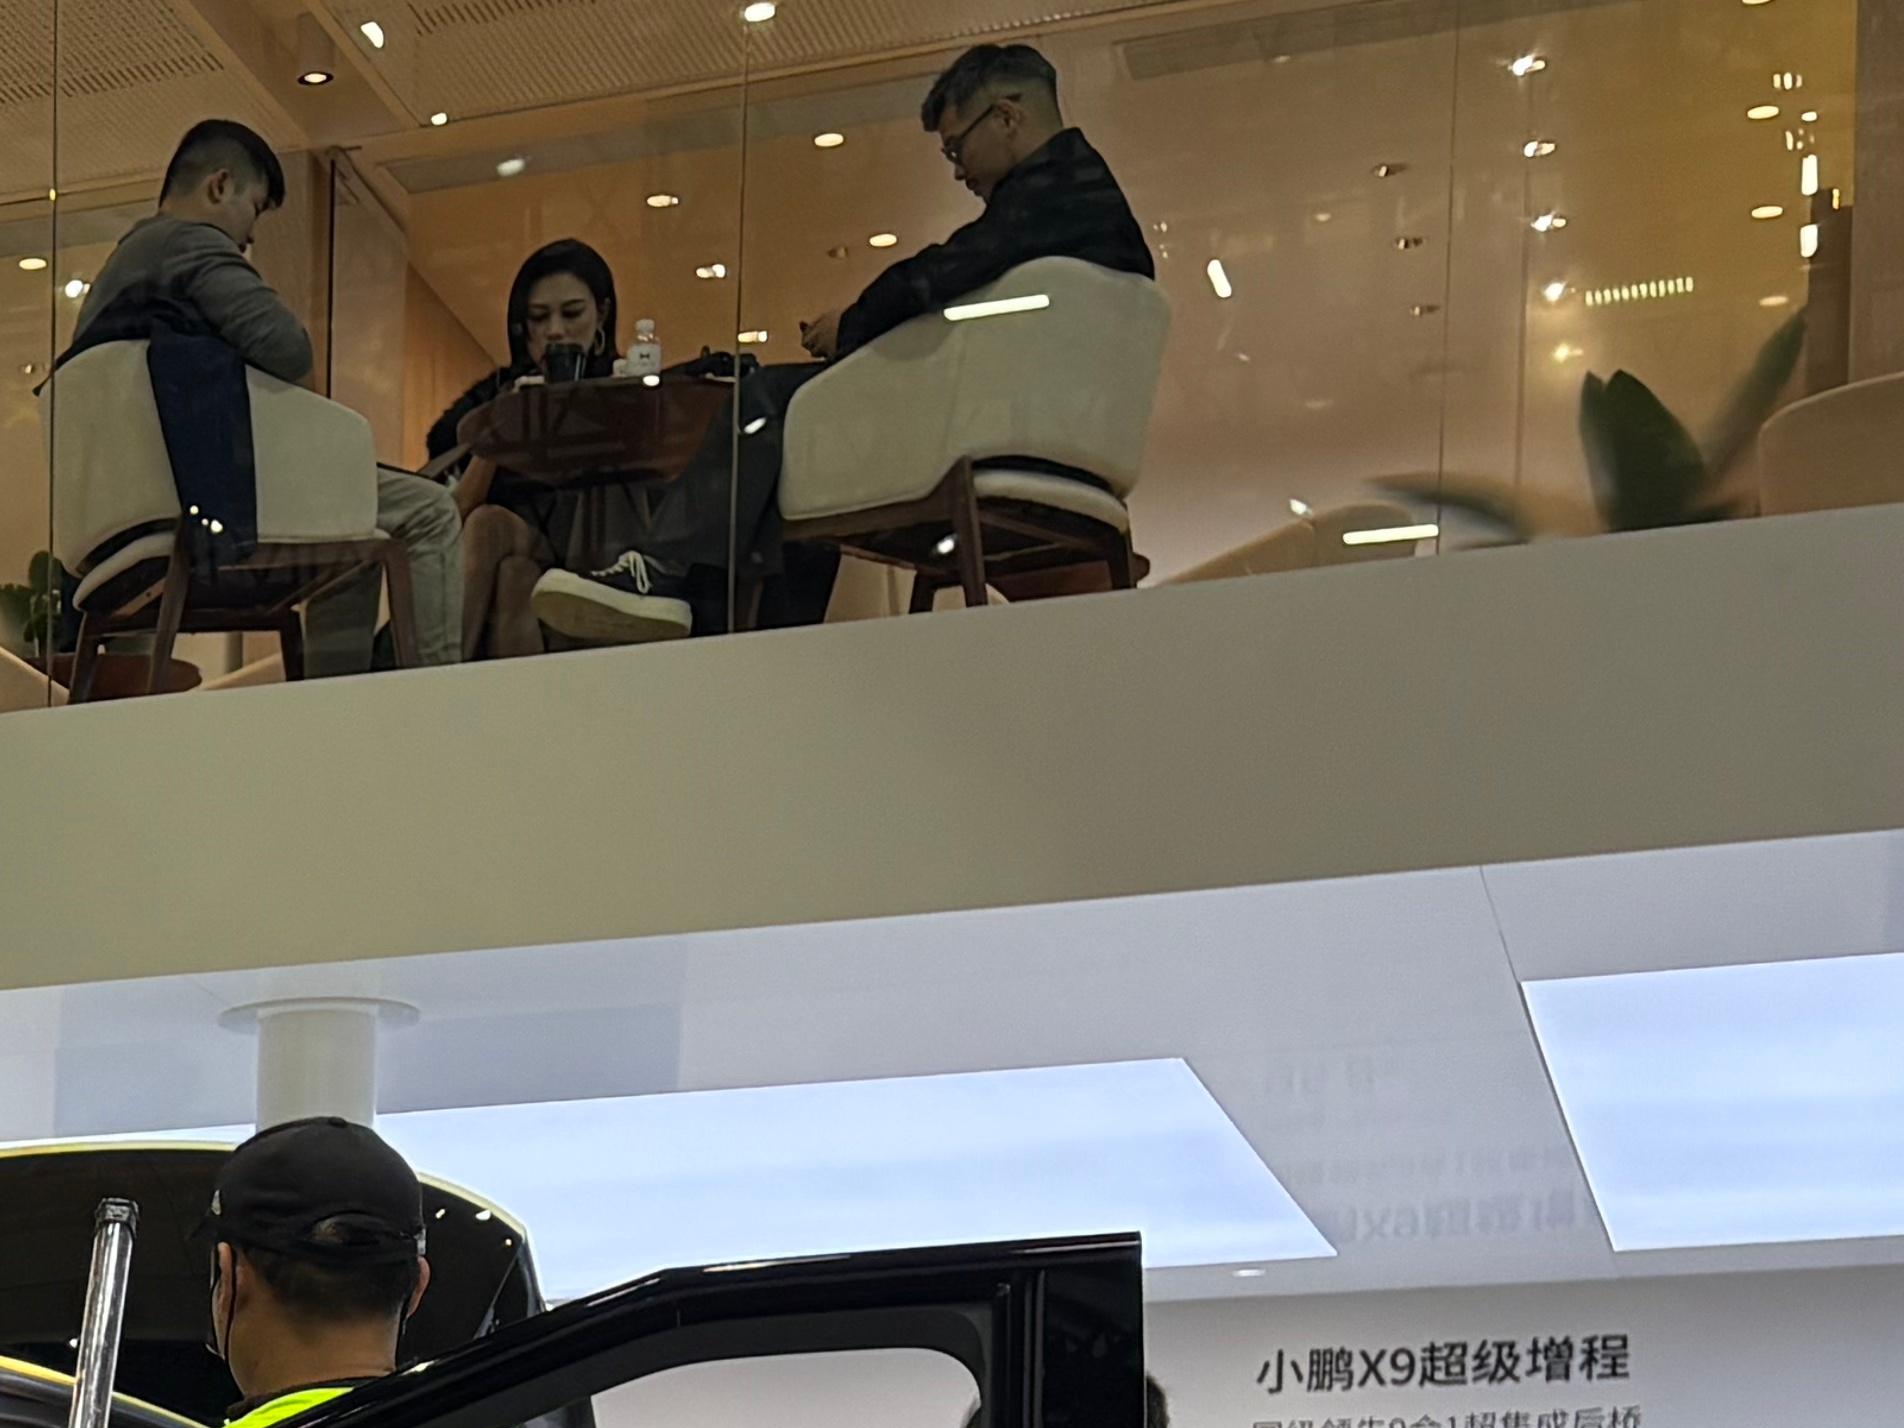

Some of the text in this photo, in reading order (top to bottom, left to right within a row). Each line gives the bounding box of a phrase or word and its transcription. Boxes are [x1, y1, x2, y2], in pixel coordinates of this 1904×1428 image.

[1256, 1333, 1631, 1394] 小鹏X9超级增程
